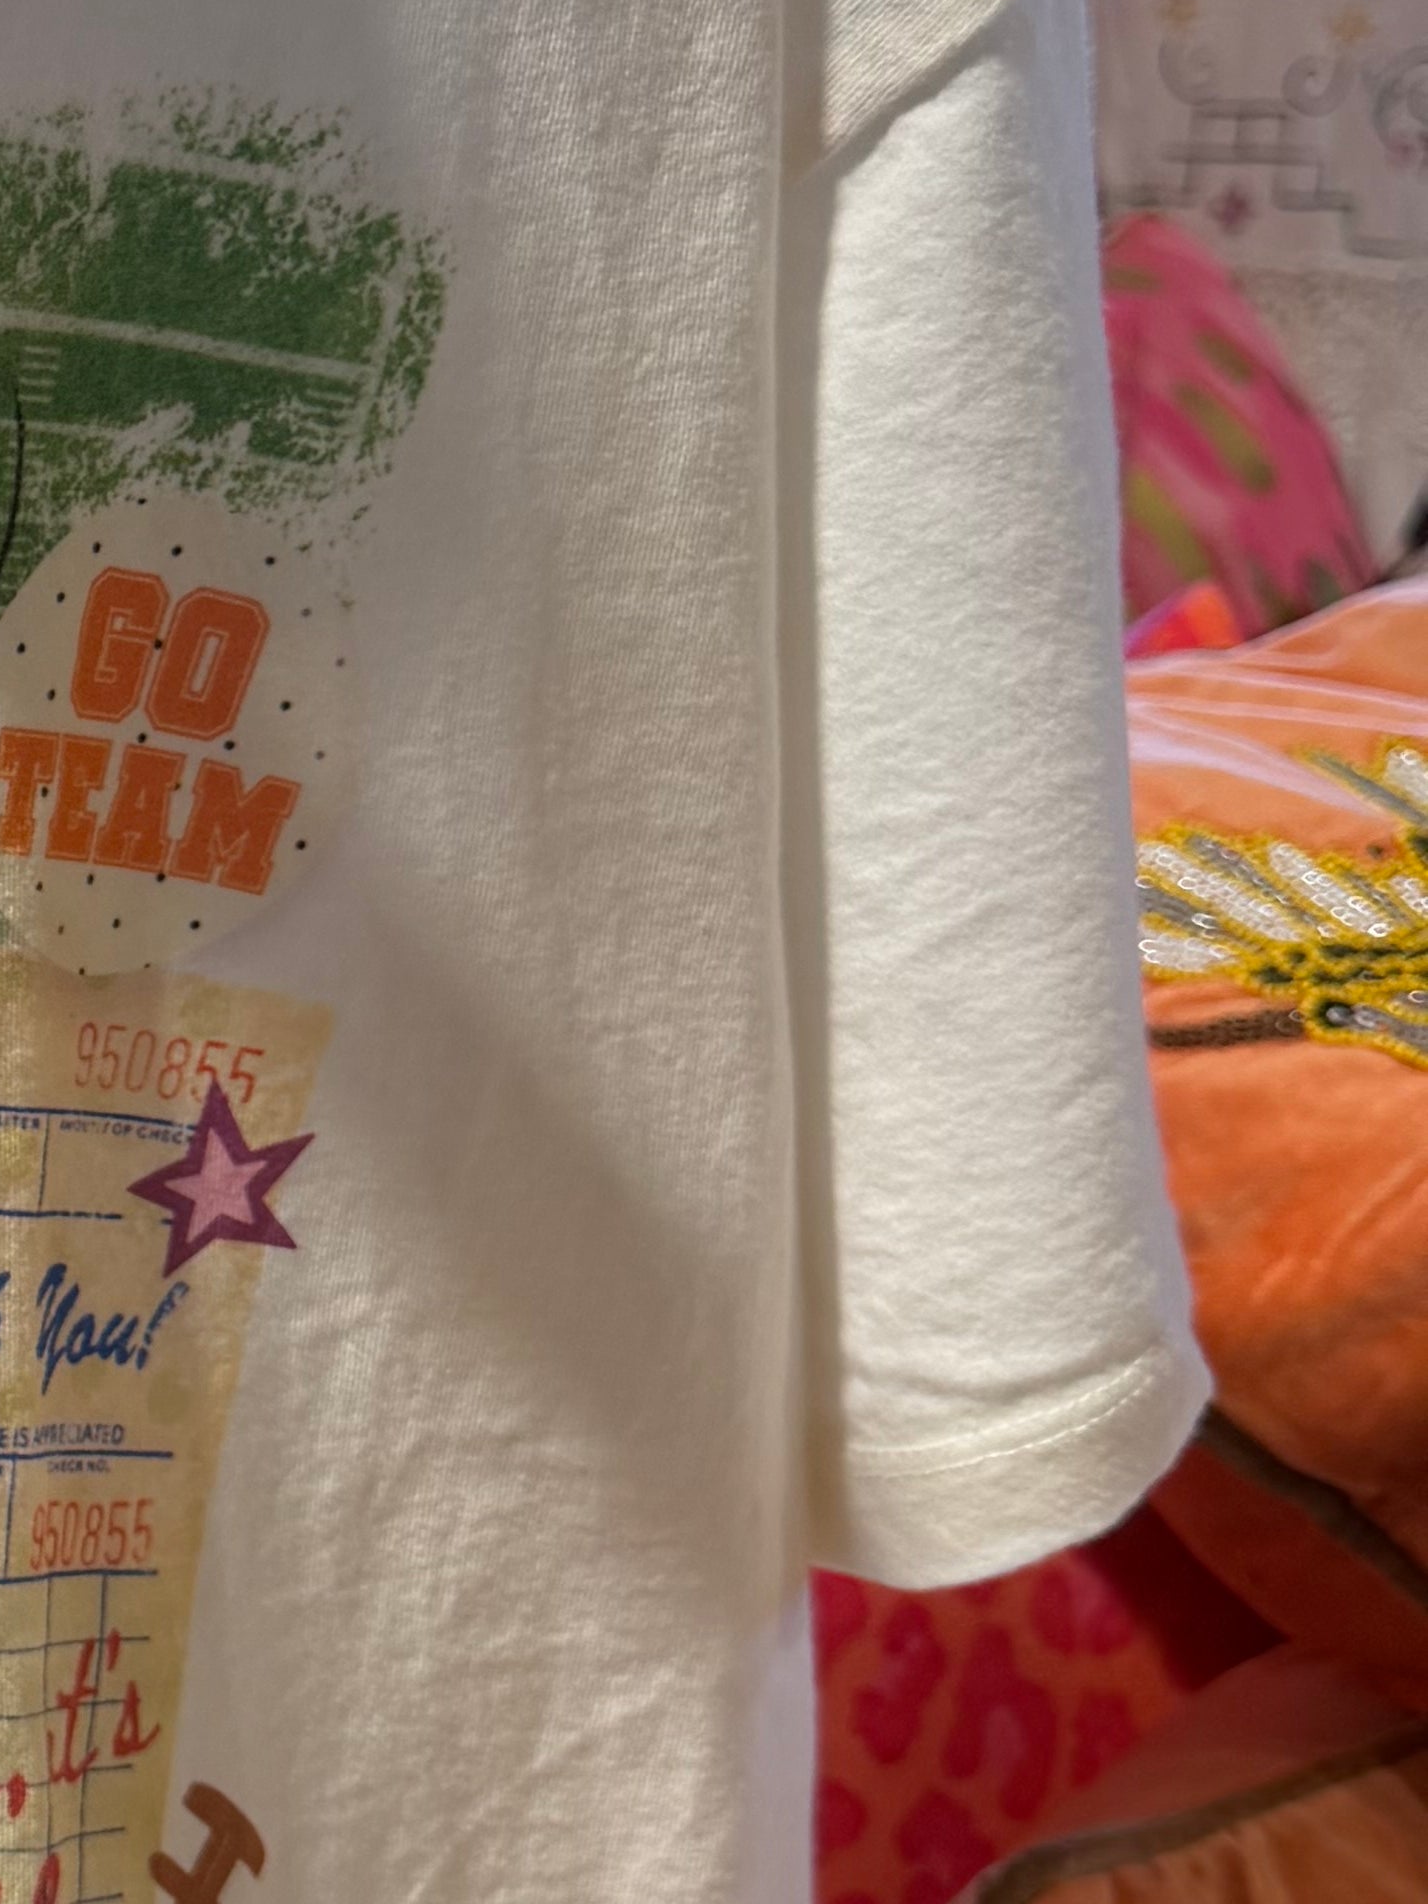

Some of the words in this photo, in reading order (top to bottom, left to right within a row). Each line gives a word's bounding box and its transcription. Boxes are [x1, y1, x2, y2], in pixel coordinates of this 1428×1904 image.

[70, 566, 271, 742] GO
[36, 1261, 190, 1396] You!
[13, 1425, 29, 1447] IS
